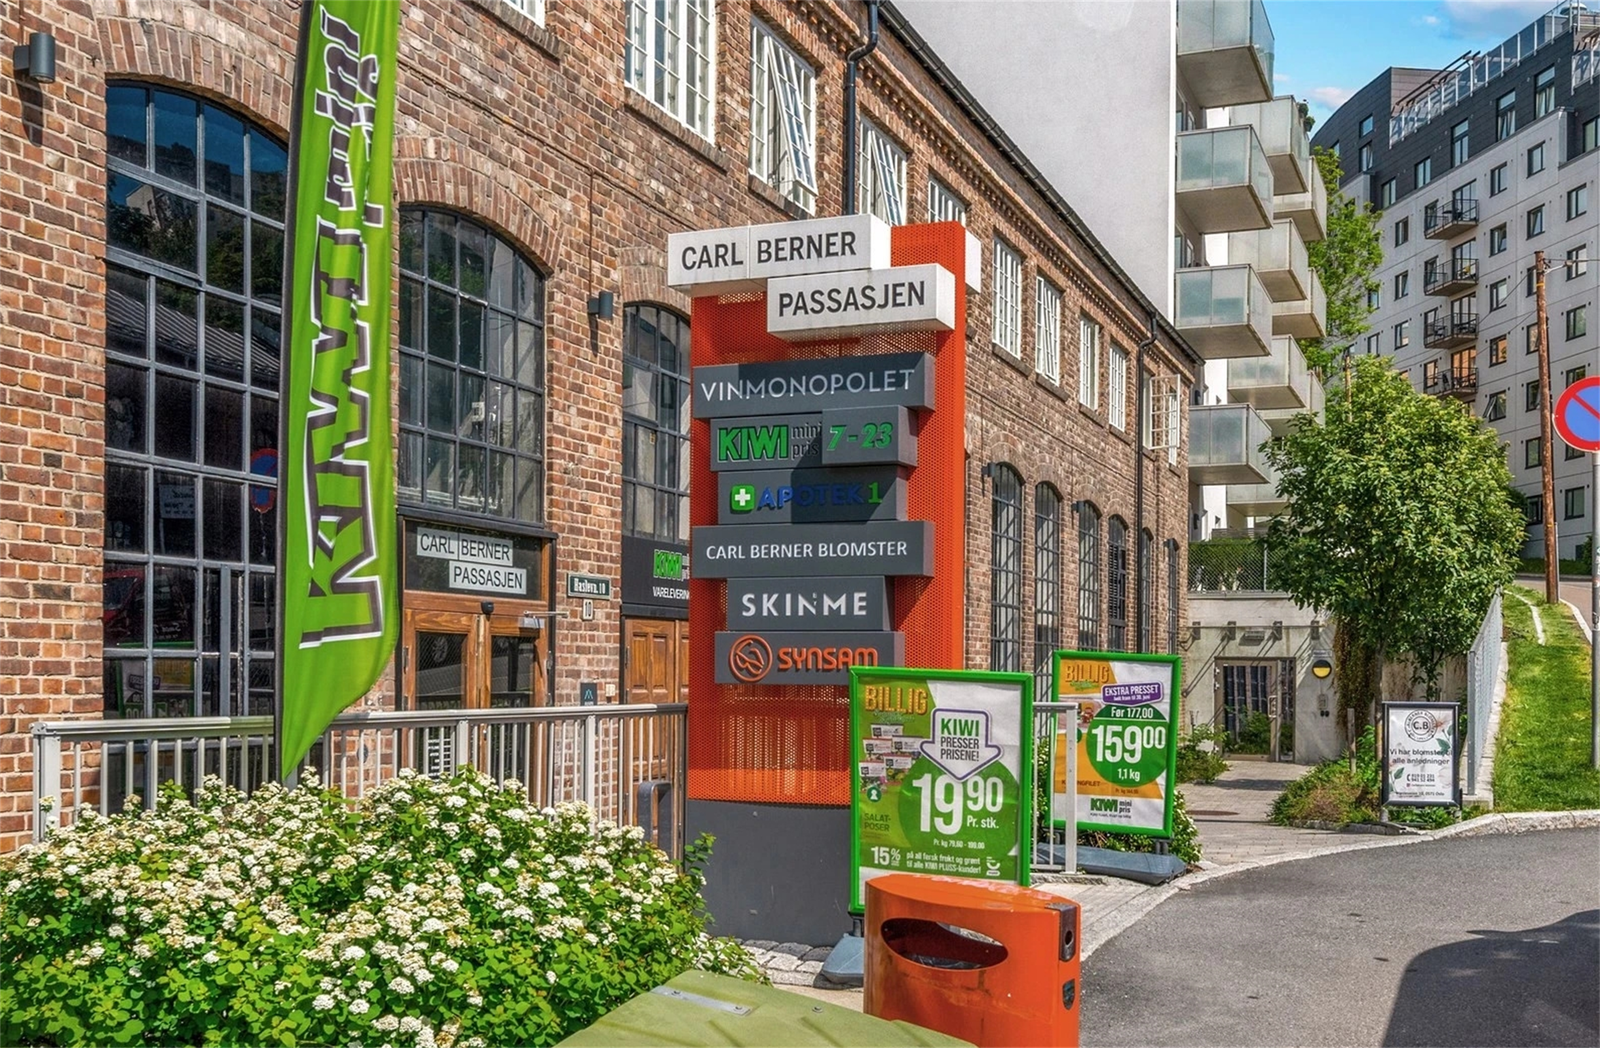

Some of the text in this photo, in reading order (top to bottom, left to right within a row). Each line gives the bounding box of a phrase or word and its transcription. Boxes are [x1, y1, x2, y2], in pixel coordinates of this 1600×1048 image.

[681, 231, 857, 271] CARL BERNER
[778, 281, 926, 317] PASSASJEN
[701, 369, 915, 402] VINMONOPOLET
[790, 421, 822, 440] mini
[717, 424, 789, 463] KIWI
[790, 440, 819, 461] pris
[757, 481, 883, 510] APOTEK 1
[420, 533, 511, 562] CARL BERNER
[706, 545, 746, 560] CARL
[750, 543, 813, 559] BERNER
[818, 541, 908, 558] BLOMSTER
[653, 548, 682, 580] KIWI
[453, 565, 523, 590] PASSASJEN
[777, 647, 878, 670] SYNSAM
[1065, 664, 1110, 684] BILLIG
[1104, 684, 1159, 697] EKSTRA PRESSET
[864, 685, 928, 716] BILLIG
[1111, 707, 1154, 719] Før 177,00
[940, 718, 980, 737] KIWI
[940, 737, 980, 750] PRESSER
[940, 749, 980, 762] PRISENE!
[1118, 768, 1140, 782] 1,1 kg
[1090, 798, 1118, 812] KIWI
[864, 812, 891, 822] SALAT-
[967, 816, 1000, 829] Pr. stk.
[864, 822, 890, 832] POSER
[871, 846, 901, 865] 15%
[914, 861, 923, 869] alle
[956, 857, 963, 865] og
